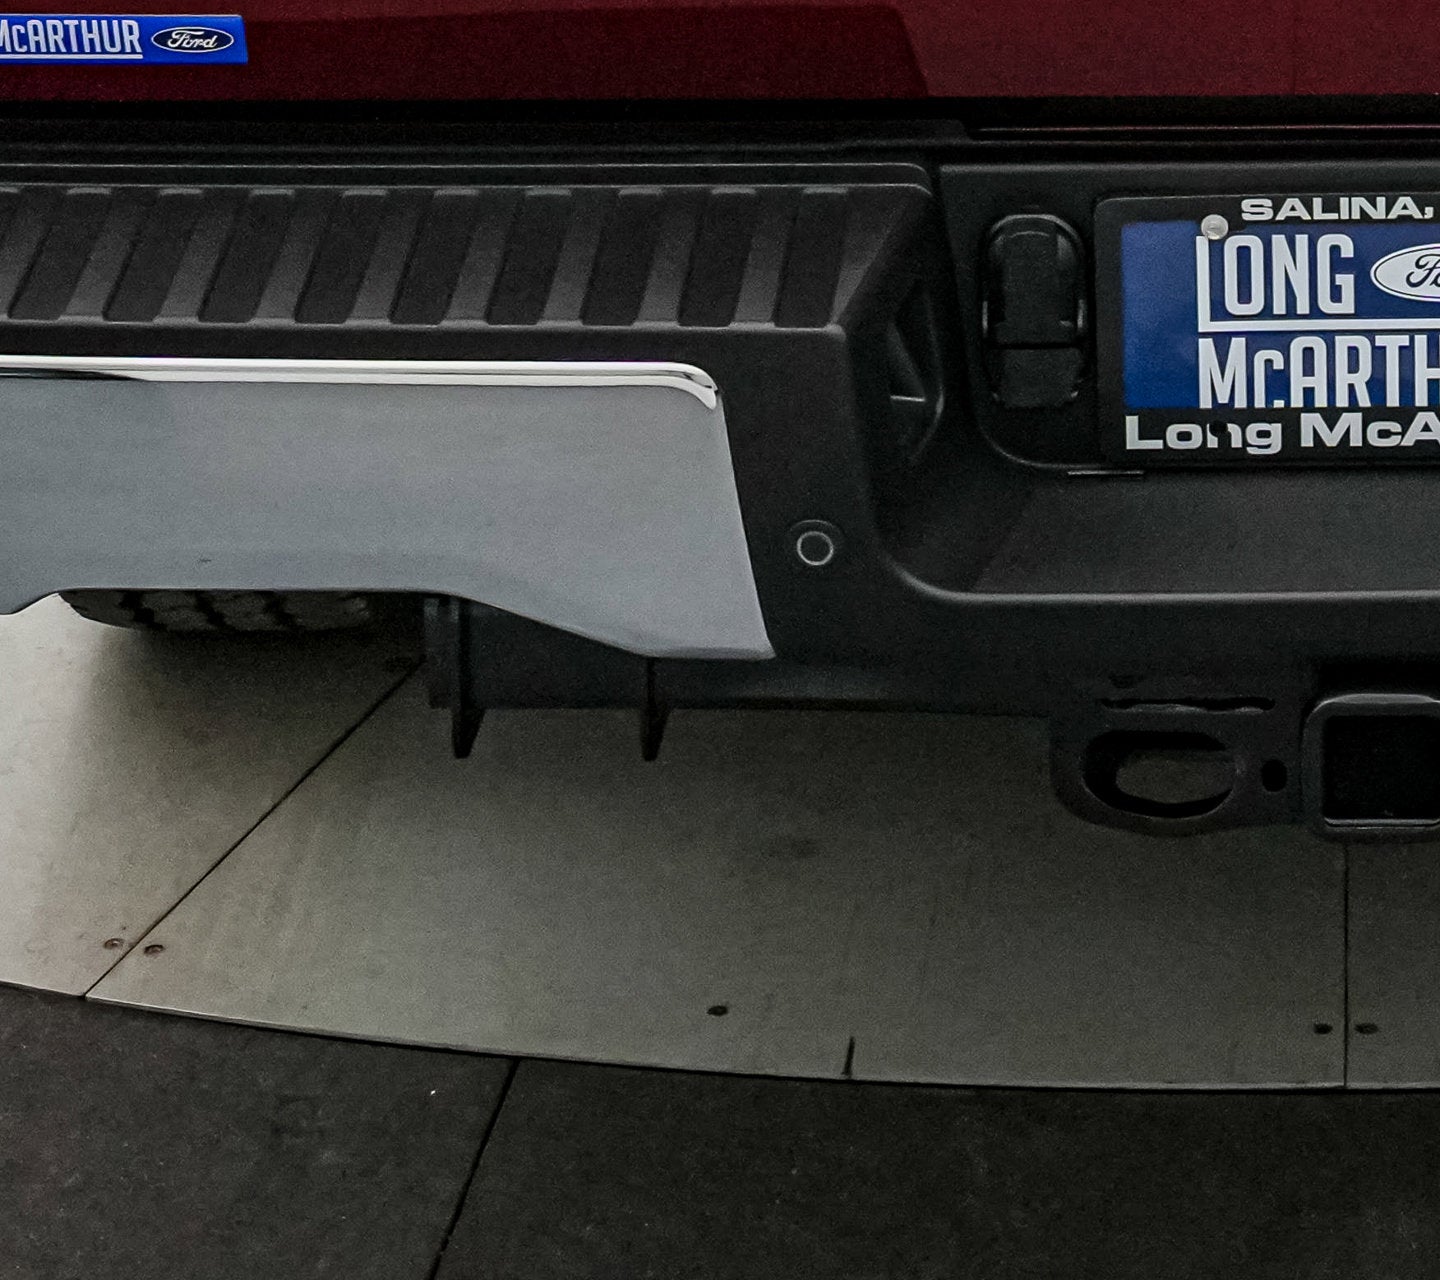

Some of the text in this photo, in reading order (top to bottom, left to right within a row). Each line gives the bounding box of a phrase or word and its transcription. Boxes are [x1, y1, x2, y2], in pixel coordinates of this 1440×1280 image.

[165, 25, 218, 50] Ford
[1240, 196, 1434, 222] SALINA,
[1195, 233, 1356, 332] LONG
[1124, 413, 1283, 456] Long
